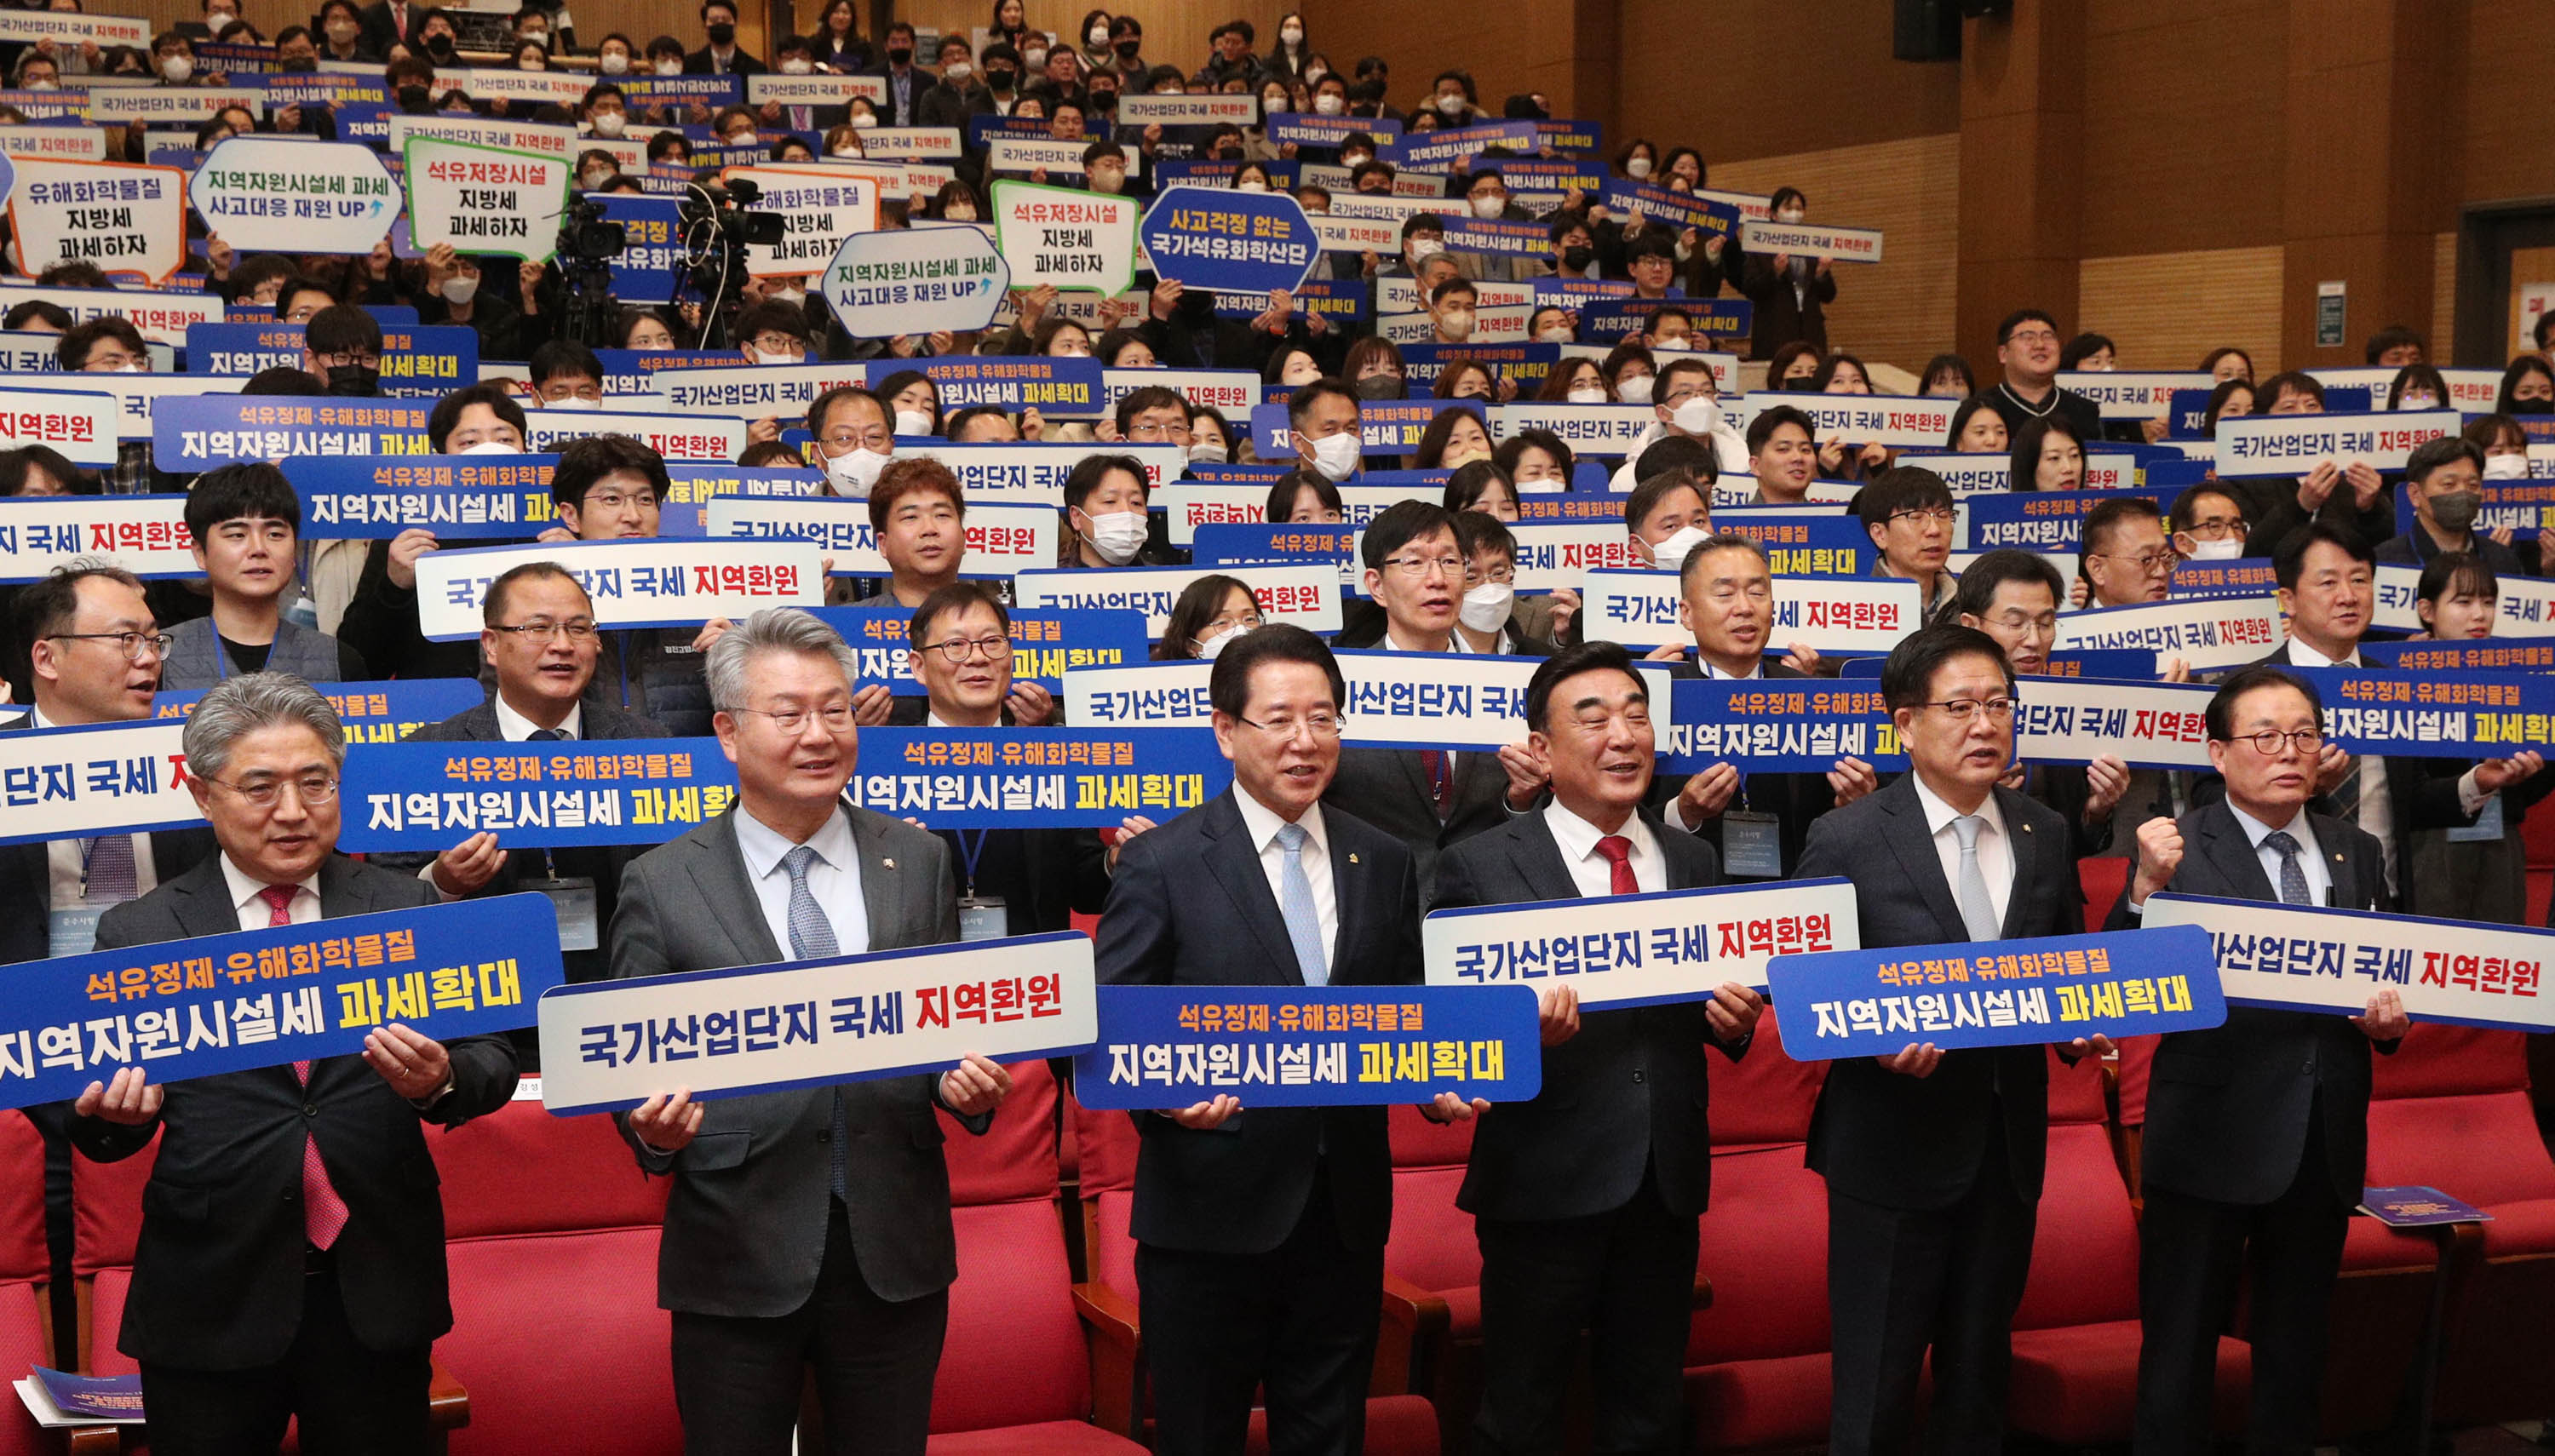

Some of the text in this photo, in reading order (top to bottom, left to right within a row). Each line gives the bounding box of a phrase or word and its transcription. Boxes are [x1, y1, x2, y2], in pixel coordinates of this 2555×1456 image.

[759, 84, 818, 97] 국가산업단지
[820, 85, 839, 96] 국세
[102, 97, 174, 112] 국가산업단지
[178, 98, 200, 111] 국세
[1129, 103, 1187, 117] 국가산업단지
[1189, 103, 1208, 116] 국세
[10, 138, 36, 150] 국세
[893, 136, 911, 149] 국세
[1278, 126, 1347, 142] 지역자원시설
[1002, 148, 1064, 163] 국가산업단지
[209, 170, 389, 196] 지역자원시설세 과세
[428, 161, 546, 186] 석유저장시설
[29, 178, 162, 204] 유해화학물질
[459, 190, 517, 211] 지방세
[67, 207, 132, 230] 지방세
[210, 195, 366, 219] 사고대응 재원 UP
[1013, 203, 1117, 224] 석유저장시설
[450, 215, 528, 238] 과세하자
[1169, 209, 1291, 239] 사고걱정 없는
[1324, 225, 1392, 244] 국세 지역환원
[59, 234, 146, 260] 과세하자
[1042, 229, 1093, 249] 지방세
[1151, 232, 1307, 266] 국가석유화학산단
[1752, 231, 1811, 247] 국가산업단지
[1812, 234, 1831, 249] 국세
[839, 256, 996, 284] 지역자원시설세 과세
[1035, 253, 1103, 274] 과세하자
[840, 280, 977, 307] 사고대응 재원 UP
[1071, 303, 1094, 319] 국세
[671, 381, 776, 407] 국가산업단지
[780, 381, 814, 403] 국세
[1023, 382, 1089, 404] 과세확대
[1186, 387, 1248, 407] 지역환원
[2122, 388, 2149, 404] 국세
[2443, 382, 2495, 401] 역환원
[239, 407, 425, 427] 석유정제·유해화학물질
[1616, 421, 1642, 439] 국세
[1855, 411, 1947, 433] 국세 지역환원
[181, 431, 371, 456] 지역자원시설세
[649, 433, 728, 459] 지역환원
[2232, 432, 2374, 458] 국가산업단지 국세
[310, 493, 516, 525] 지역자원시설세
[26, 525, 82, 553] 국세
[1981, 519, 2084, 546] 지역자원시
[1515, 545, 1556, 570] 국세
[1769, 547, 1856, 576] 과세확대
[630, 564, 800, 598] 국세 지역환원
[1806, 600, 1899, 631] 지역환원
[2502, 597, 2541, 622] 국세
[2185, 617, 2272, 647] 국세 지역환원
[2340, 679, 2521, 707] 석유정제·유해화학물질
[2080, 708, 2208, 743] 국세 지역환
[2474, 712, 2555, 747] 과세확
[1668, 721, 1866, 757] 지역자원시설세
[444, 751, 692, 782] 석유정제·유해화학물질
[904, 741, 1134, 766] 석유정제·유해화학물질
[86, 754, 158, 798] 국세
[1075, 772, 1204, 810] 과세확대
[367, 788, 623, 831] 지역자원시설세
[1455, 913, 1833, 983] 국가산업단지 국세 지역환원
[84, 928, 417, 1005] 석유정제·유해화학물질
[1876, 947, 2111, 987] 석유정제·유해화학물질
[2353, 944, 2414, 985] 국세
[2420, 950, 2541, 997] 지역환원
[0, 957, 524, 1082] 지역자원시설세 과세확대
[1178, 1002, 1424, 1033] 석유정제·유해화학물질
[1810, 973, 2194, 1040] 지역자원시설세 과세확대
[578, 972, 1063, 1069] 국가산업단지 국세 지역환원
[1108, 1039, 1506, 1087] 지역자원시설세 과세확대
